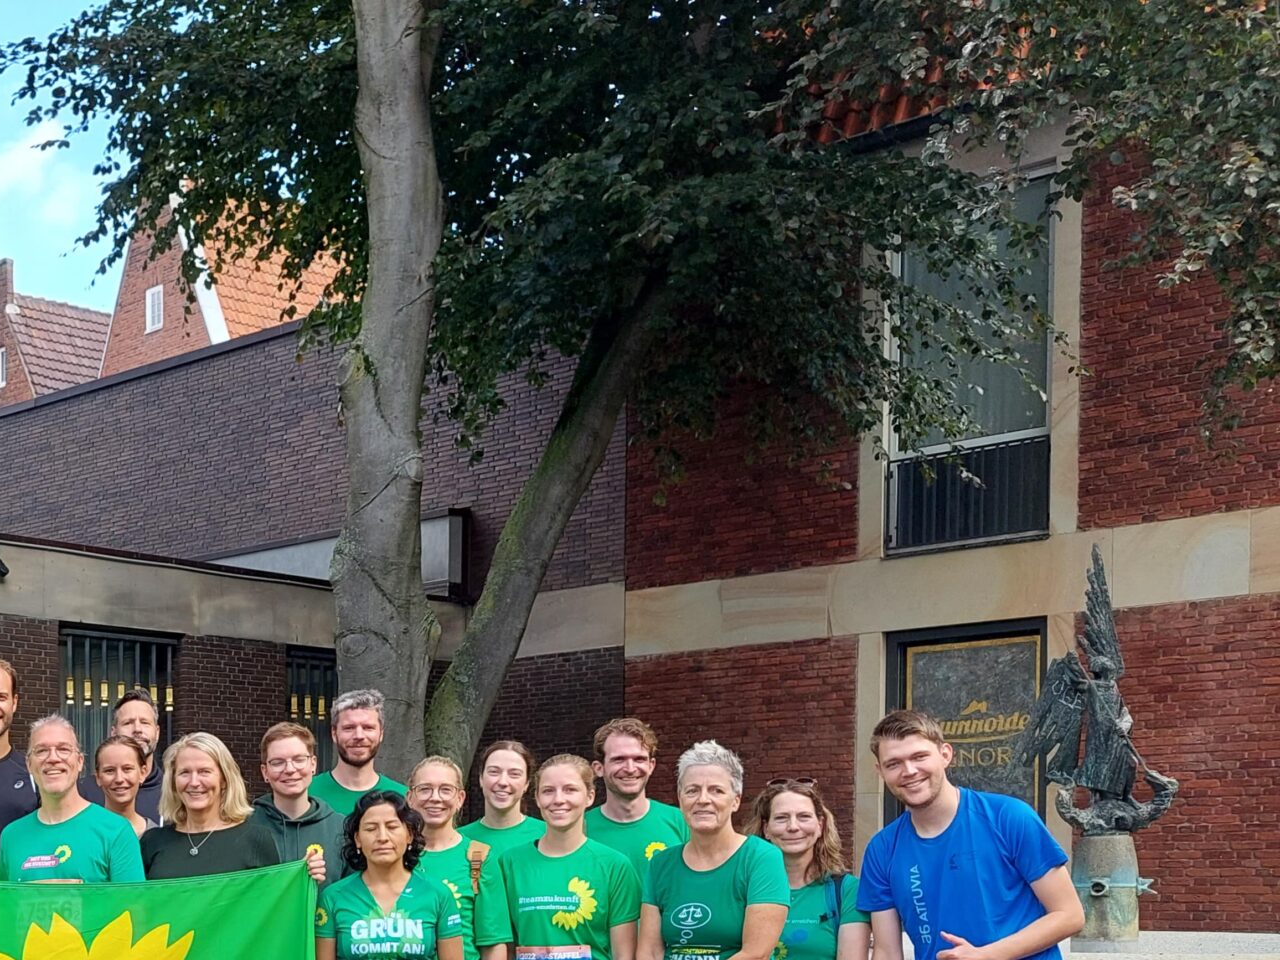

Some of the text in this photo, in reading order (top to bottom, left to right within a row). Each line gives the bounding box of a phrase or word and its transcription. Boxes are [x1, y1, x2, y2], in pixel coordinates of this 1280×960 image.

[350, 912, 424, 940] GRÜN
[350, 942, 426, 954] KOMMT AN!
[549, 951, 580, 960] STAFFEL
